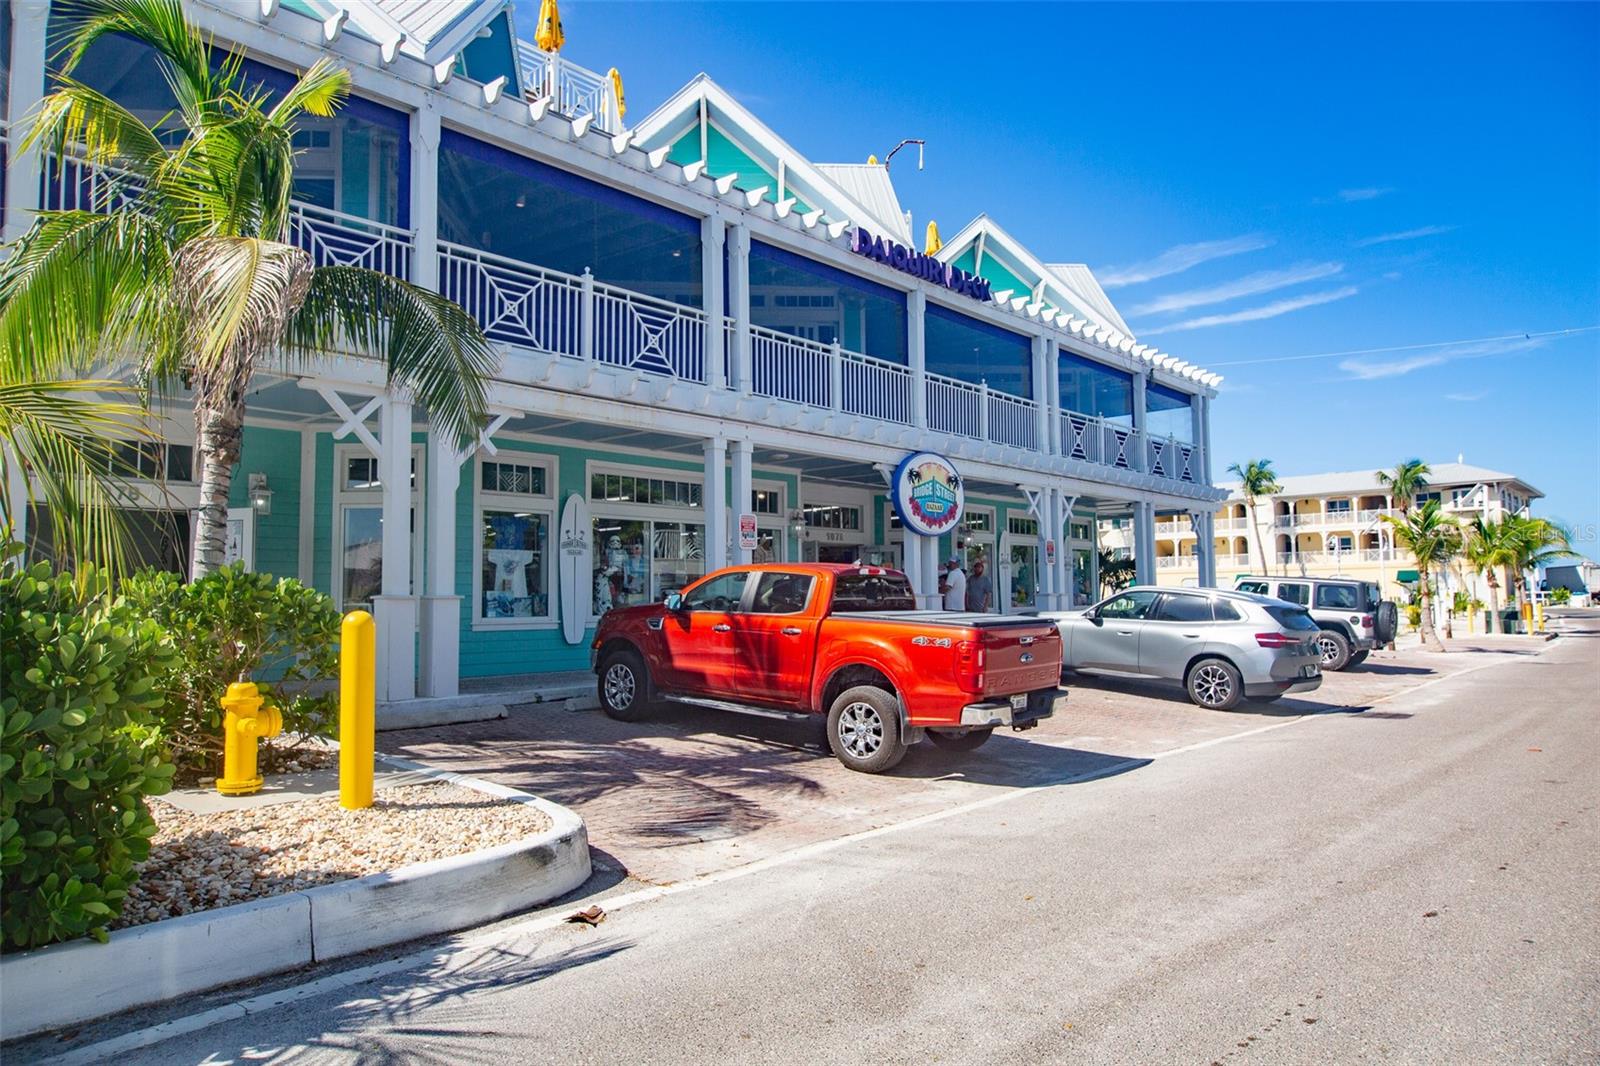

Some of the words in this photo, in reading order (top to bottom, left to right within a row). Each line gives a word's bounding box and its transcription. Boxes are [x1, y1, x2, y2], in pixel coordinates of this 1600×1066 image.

[851, 226, 947, 287] DAIQUIRI
[936, 483, 954, 503] STREET
[987, 669, 1057, 688] RANGER
